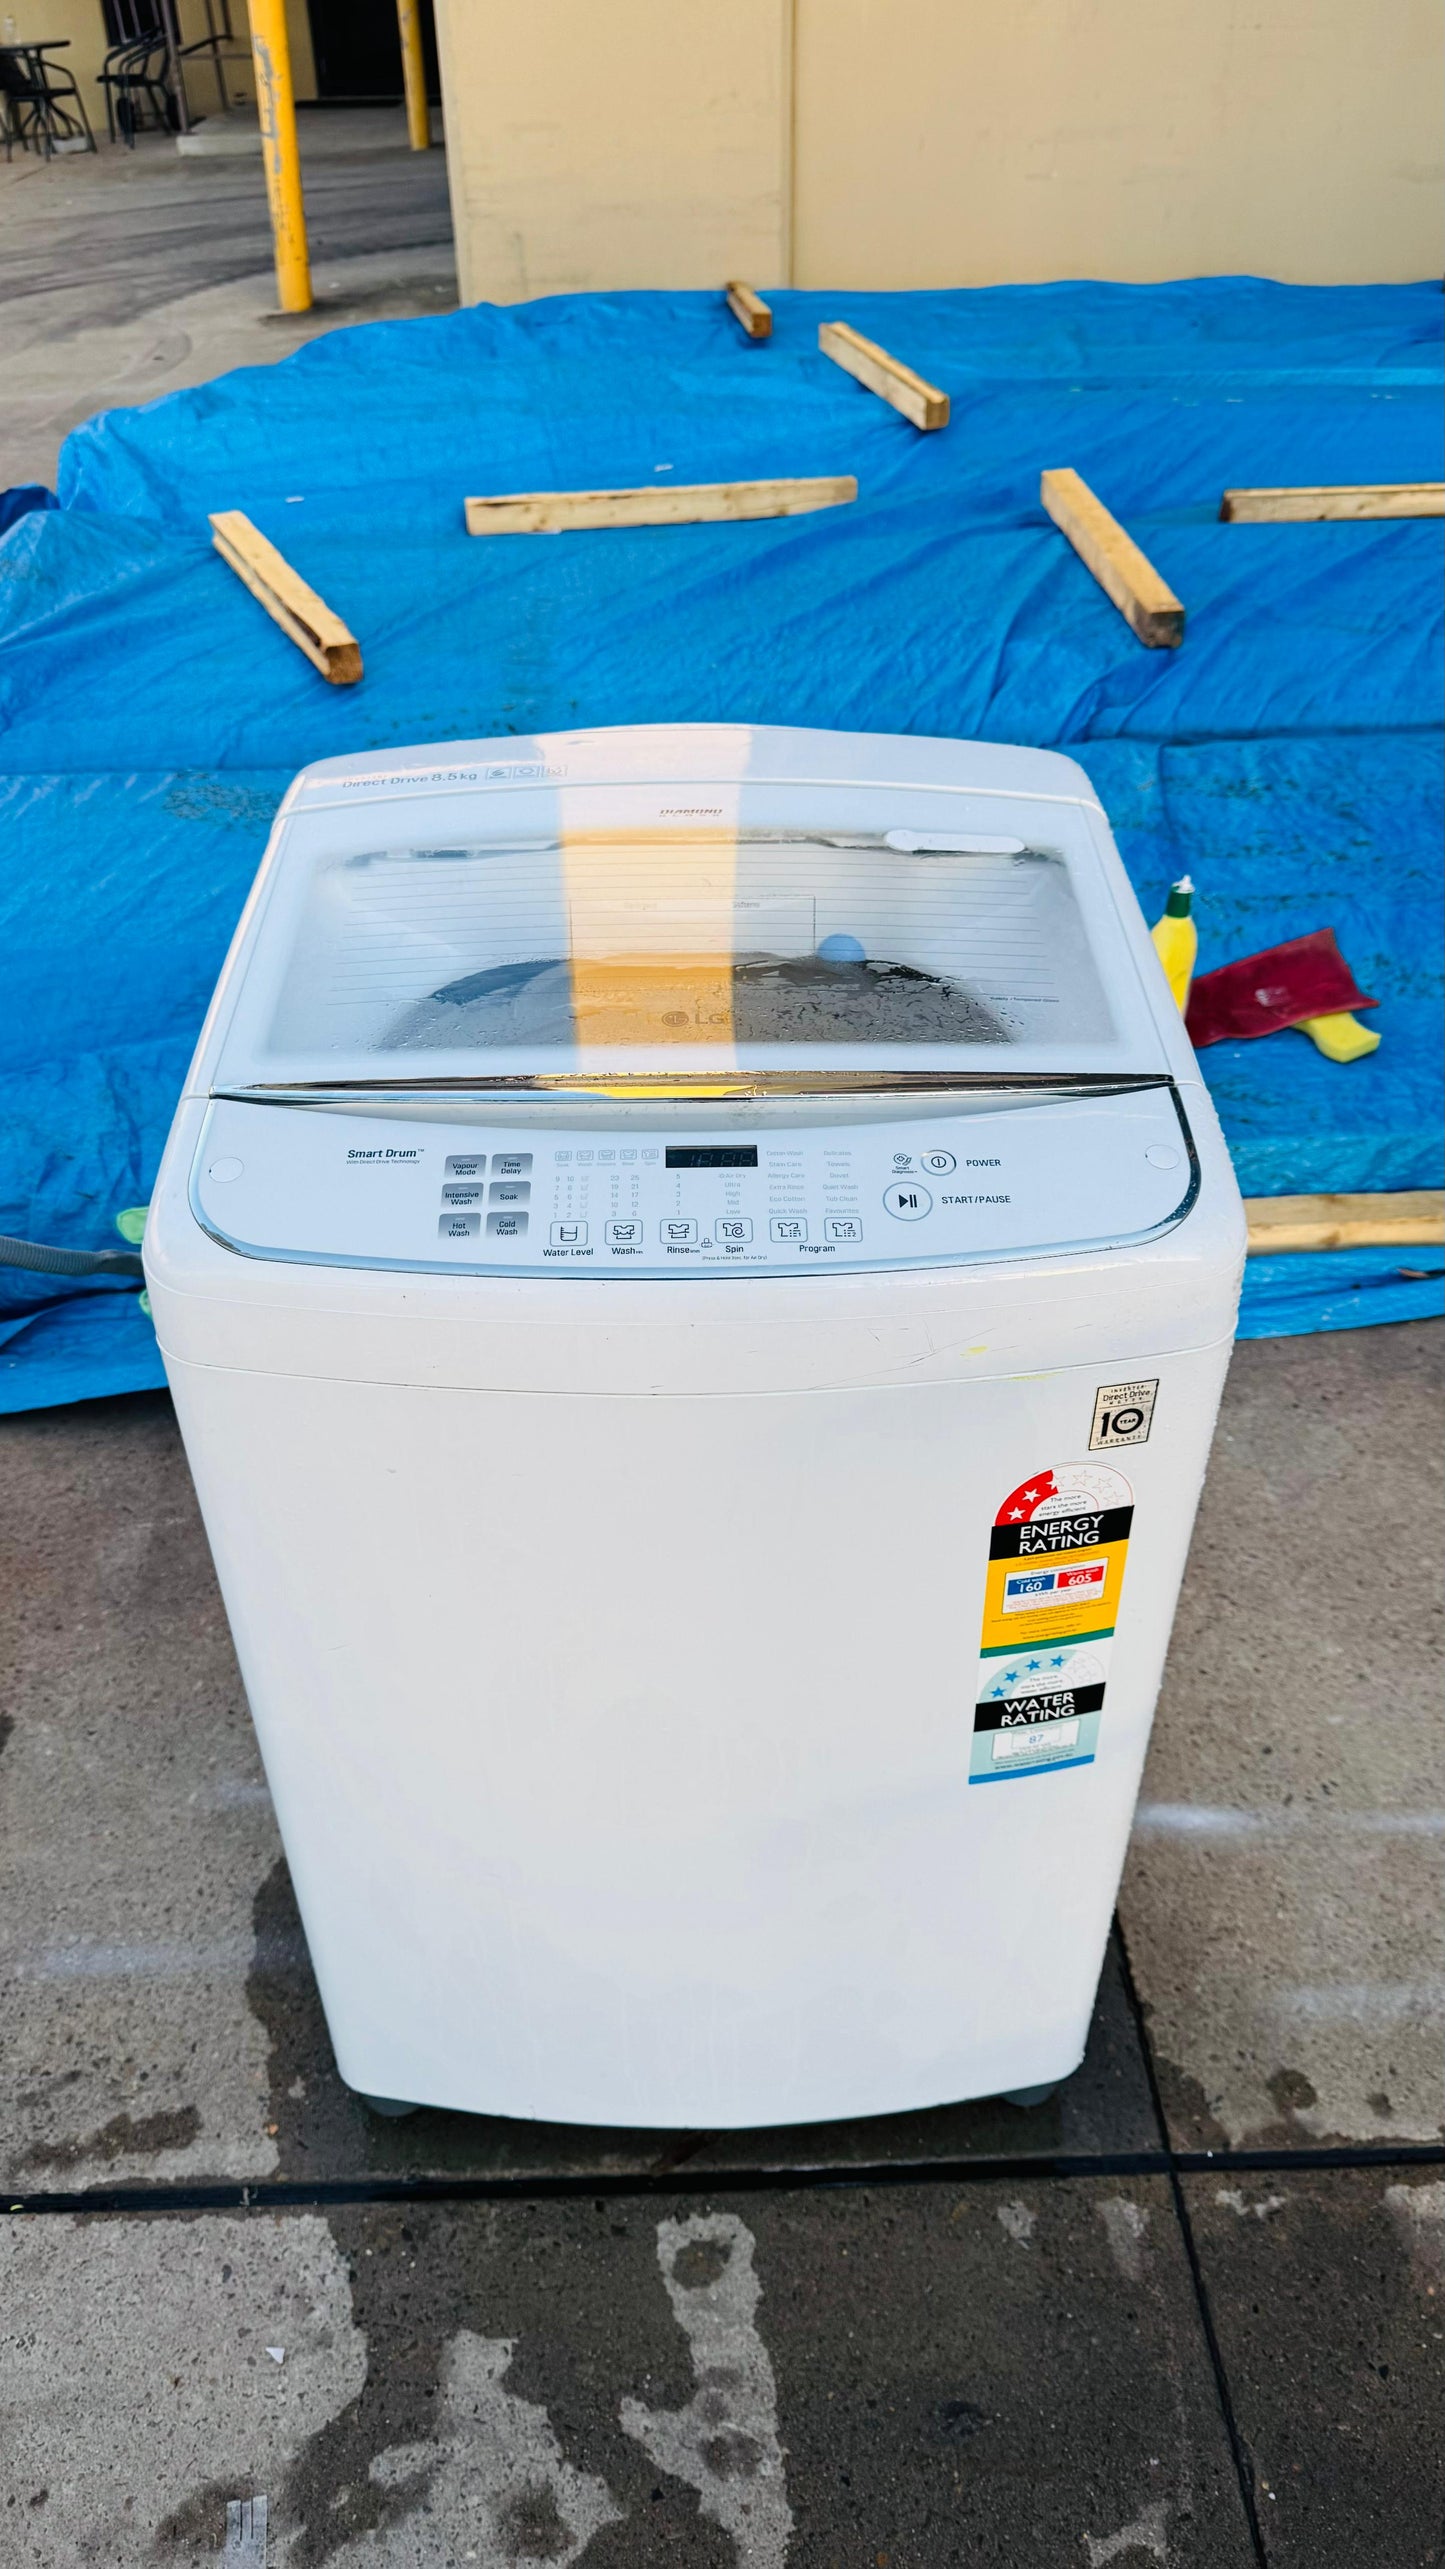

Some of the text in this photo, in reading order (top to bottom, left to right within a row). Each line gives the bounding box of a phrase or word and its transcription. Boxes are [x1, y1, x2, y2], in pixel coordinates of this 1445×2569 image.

[342, 777, 386, 788] Direct
[390, 775, 428, 785] Drive
[347, 1149, 383, 1158] Smart
[453, 1162, 478, 1170] Vapour
[966, 1159, 1001, 1167] POWER
[501, 1167, 521, 1175] Delay
[445, 1191, 479, 1199] Intensive
[941, 1195, 1012, 1204] START/PAUSE
[452, 1222, 466, 1230] Hot
[499, 1220, 516, 1228] Cold
[496, 1228, 518, 1236] Wash
[543, 1248, 594, 1257] Water Level
[611, 1247, 635, 1255] Wash
[666, 1246, 690, 1254] Rinse
[725, 1245, 744, 1254] Spin
[799, 1244, 835, 1254] Program
[1103, 1390, 1151, 1402] Direct Drive
[1101, 1408, 1144, 1437] 10
[1020, 1514, 1105, 1540] ENERGY
[1019, 1530, 1099, 1555] RATING
[1068, 1573, 1092, 1585] 605
[1019, 1581, 1042, 1593] 160
[1004, 1692, 1075, 1713] WATER
[1001, 1704, 1076, 1727] RATING
